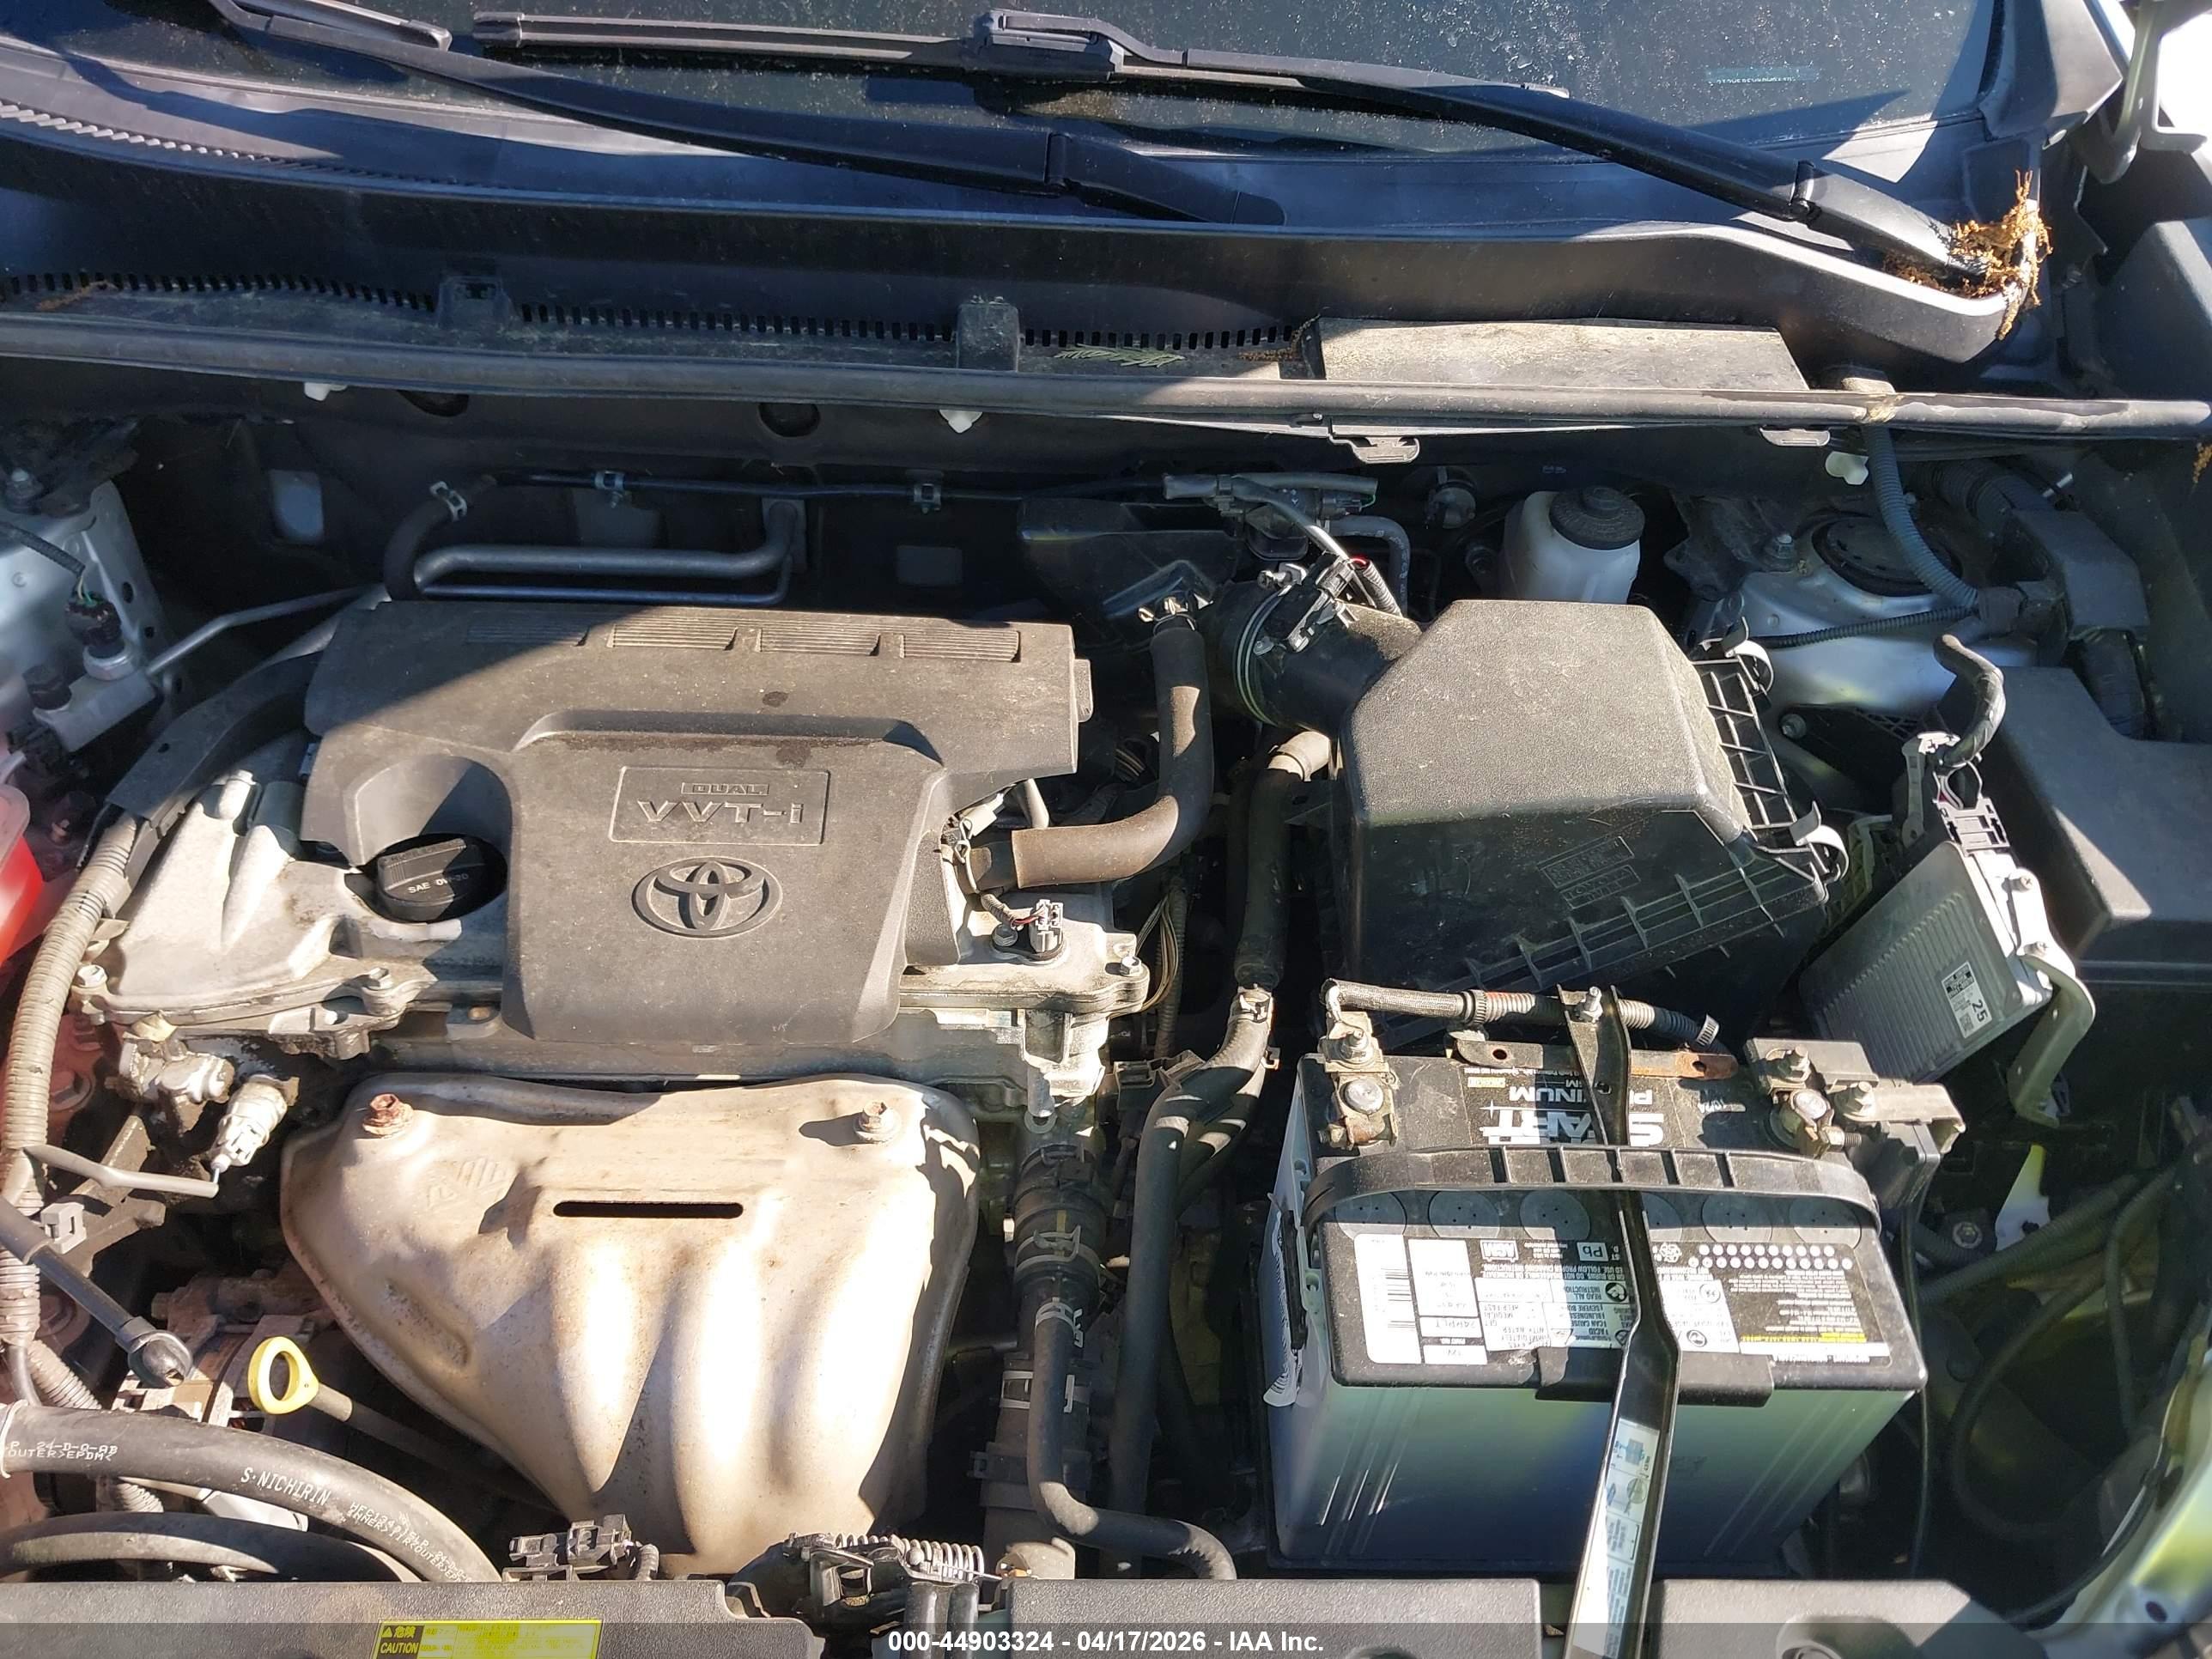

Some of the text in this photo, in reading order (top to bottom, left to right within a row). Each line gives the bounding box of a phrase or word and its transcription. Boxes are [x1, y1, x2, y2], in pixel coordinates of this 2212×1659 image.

[691, 783, 763, 794] DUAL
[637, 799, 805, 823] VVT-i
[407, 882, 431, 894] SAE
[1972, 999, 1988, 1023] 25
[1509, 1085, 1653, 1105] PINUM
[1583, 1245, 1603, 1257] Pb
[380, 1642, 419, 1655] CAUTION
